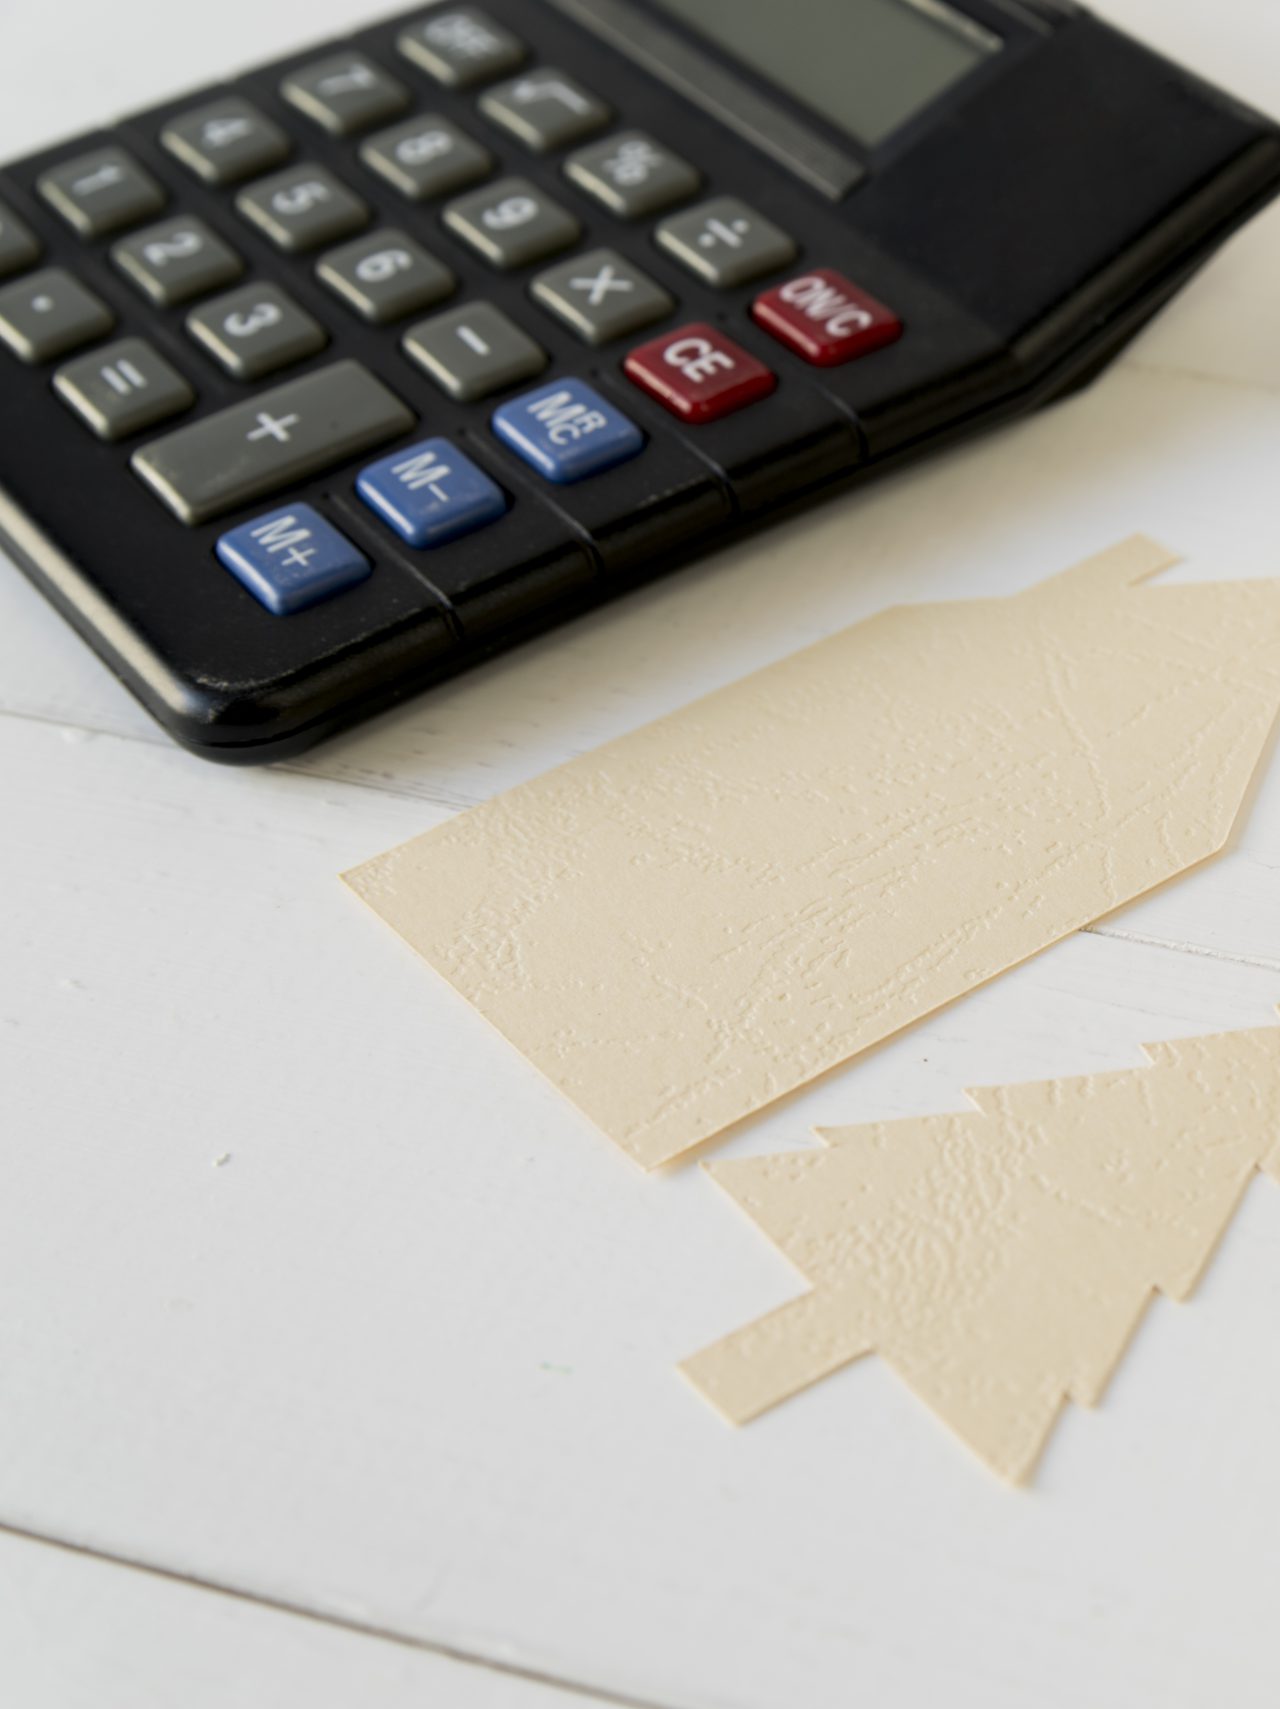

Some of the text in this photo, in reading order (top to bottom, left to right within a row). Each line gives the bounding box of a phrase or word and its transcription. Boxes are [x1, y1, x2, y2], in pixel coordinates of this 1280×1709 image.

[202, 117, 252, 148] 4
[396, 130, 453, 165] 8
[72, 166, 121, 196] 1
[272, 181, 330, 215] 5
[482, 197, 538, 230] 9
[144, 232, 202, 266] 2
[355, 250, 412, 282] 6
[223, 303, 281, 337] 3
[780, 275, 873, 338] ON/C
[664, 337, 735, 383] CE
[246, 412, 300, 442] +
[391, 452, 450, 503] M-
[250, 515, 318, 568] M+
